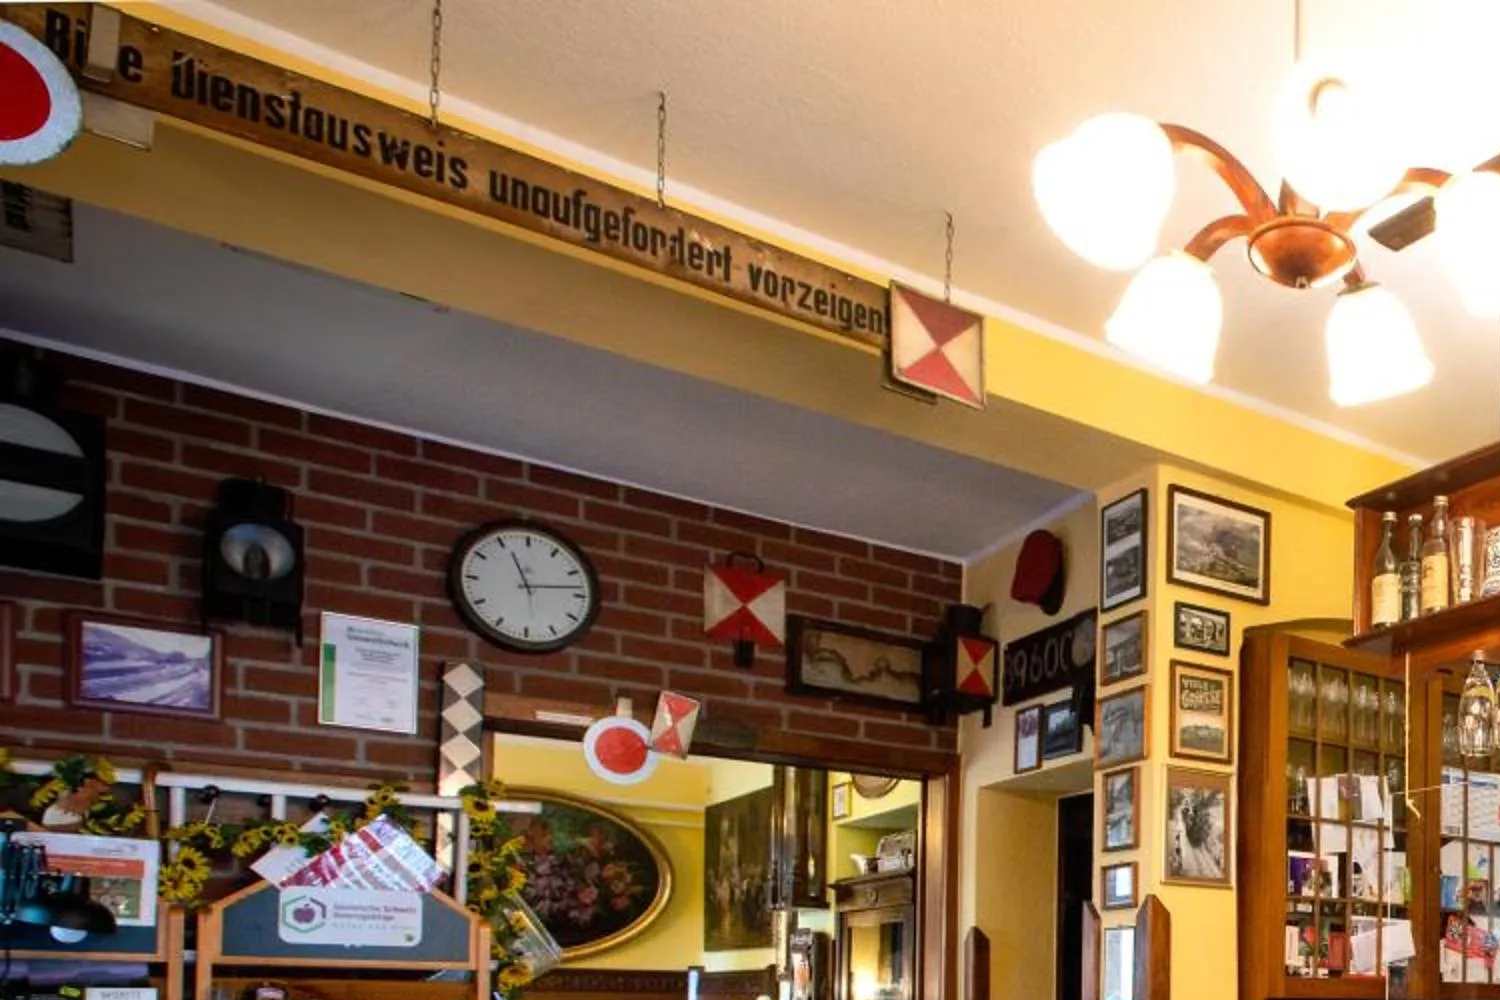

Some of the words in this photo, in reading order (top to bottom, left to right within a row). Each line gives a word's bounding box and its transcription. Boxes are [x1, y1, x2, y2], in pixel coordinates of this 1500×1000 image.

[46, 9, 143, 83] Bie
[171, 50, 469, 189] Dienstausweis
[488, 169, 732, 283] unaufgefordert
